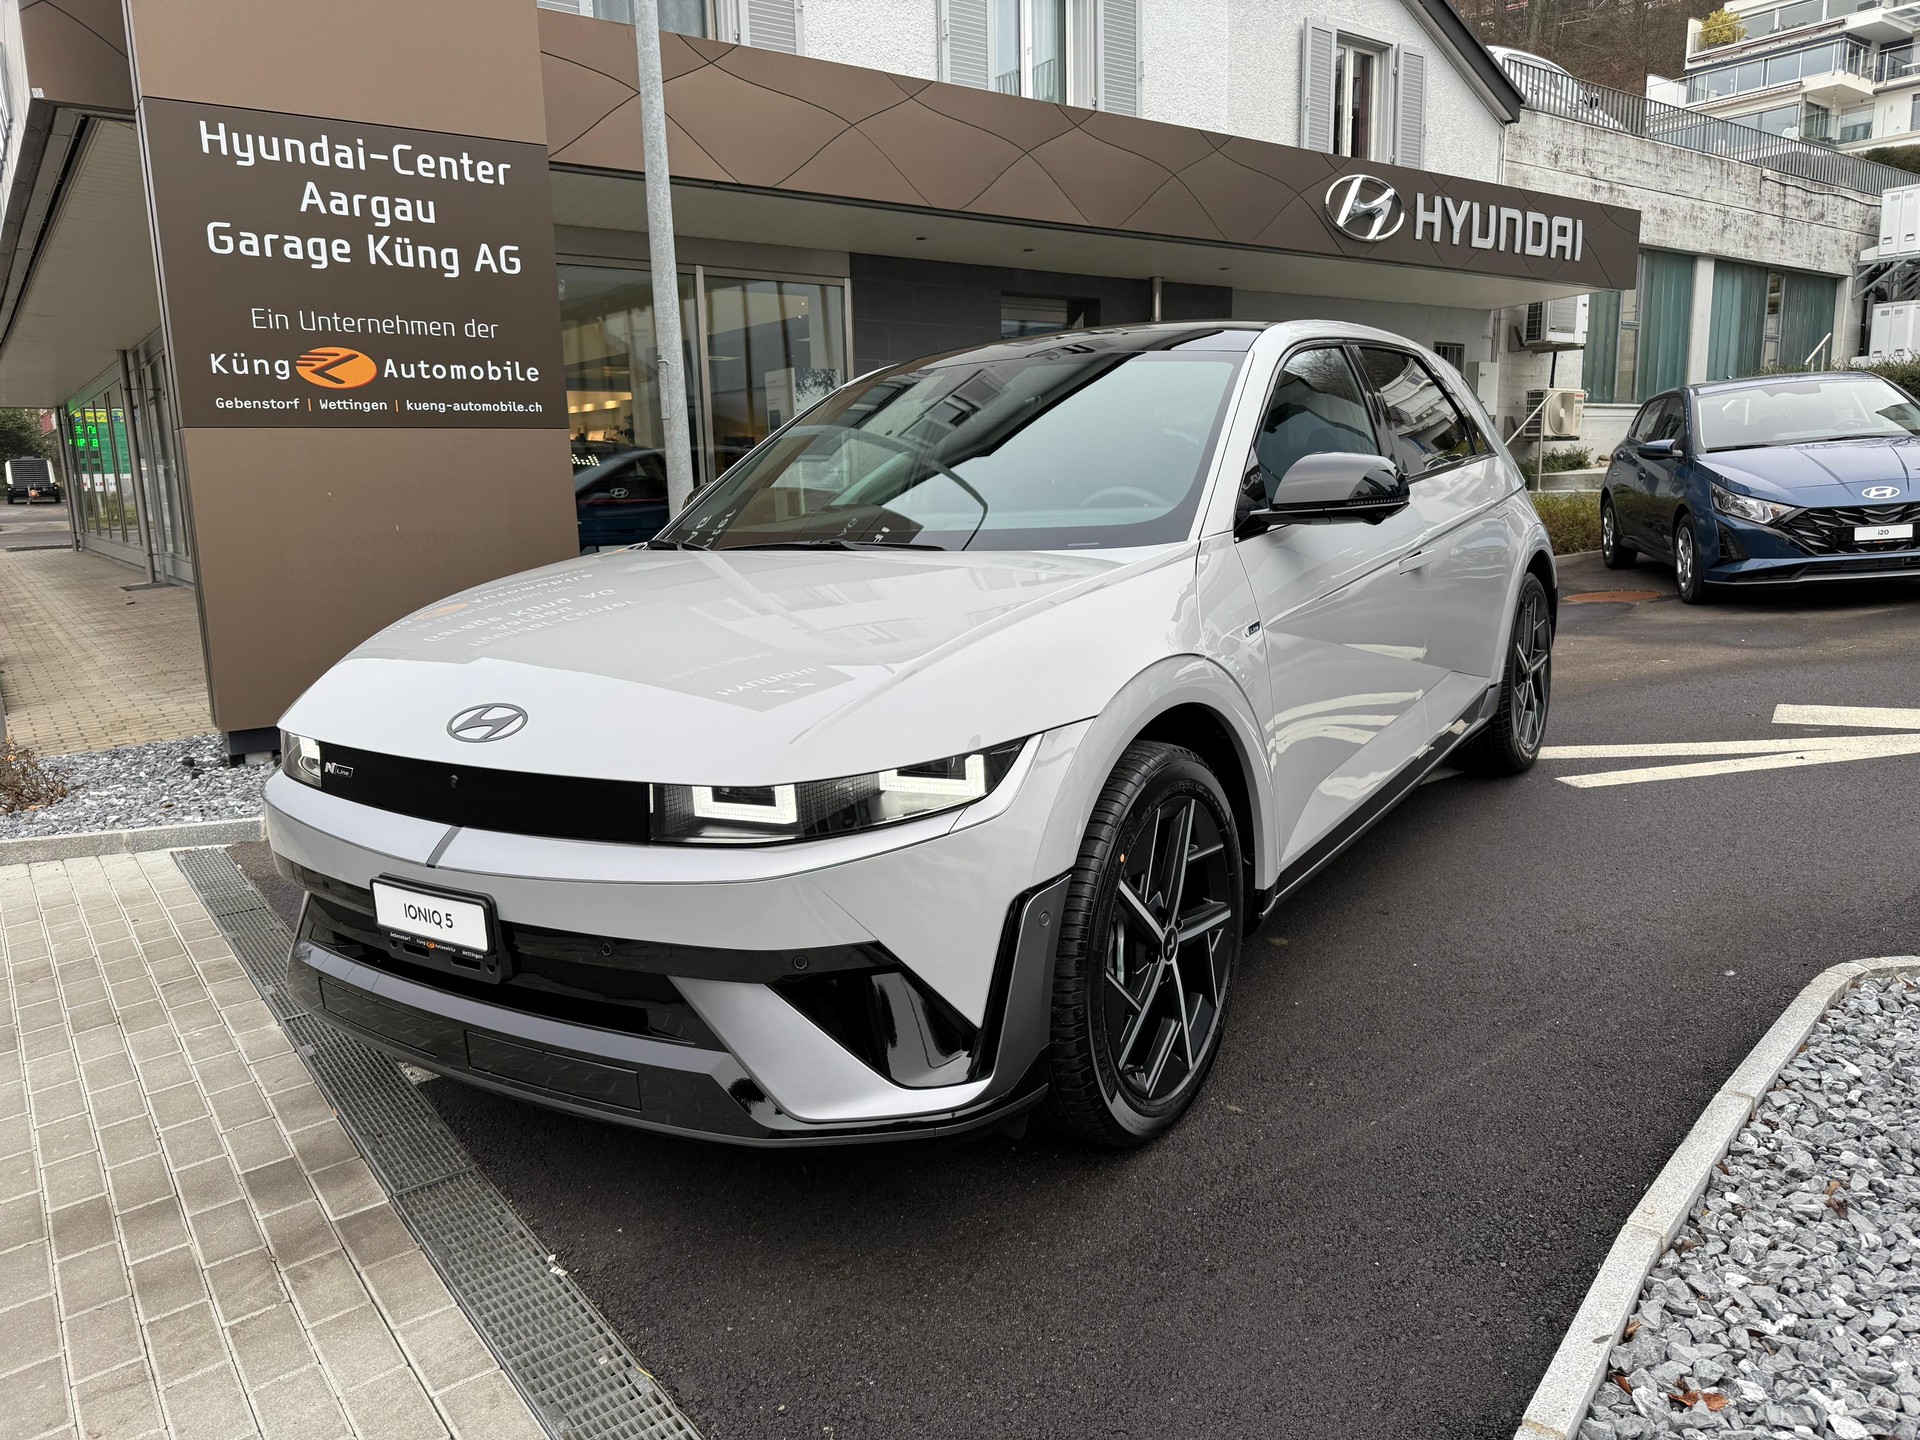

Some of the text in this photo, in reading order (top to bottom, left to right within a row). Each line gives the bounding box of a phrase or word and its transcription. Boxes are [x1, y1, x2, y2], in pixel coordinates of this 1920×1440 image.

[199, 120, 512, 186] Hyundai-Center
[300, 181, 436, 228] Aargau
[1414, 192, 1583, 262] HYUNDAI
[206, 221, 522, 278] Garage Küng AG
[251, 307, 499, 339] Ein Unternehmen der
[210, 352, 540, 382] Küng Automobile
[215, 397, 543, 413] Gebenstorf Wettingen kueng-automobile.ch
[403, 903, 454, 930] IONIQ 5
